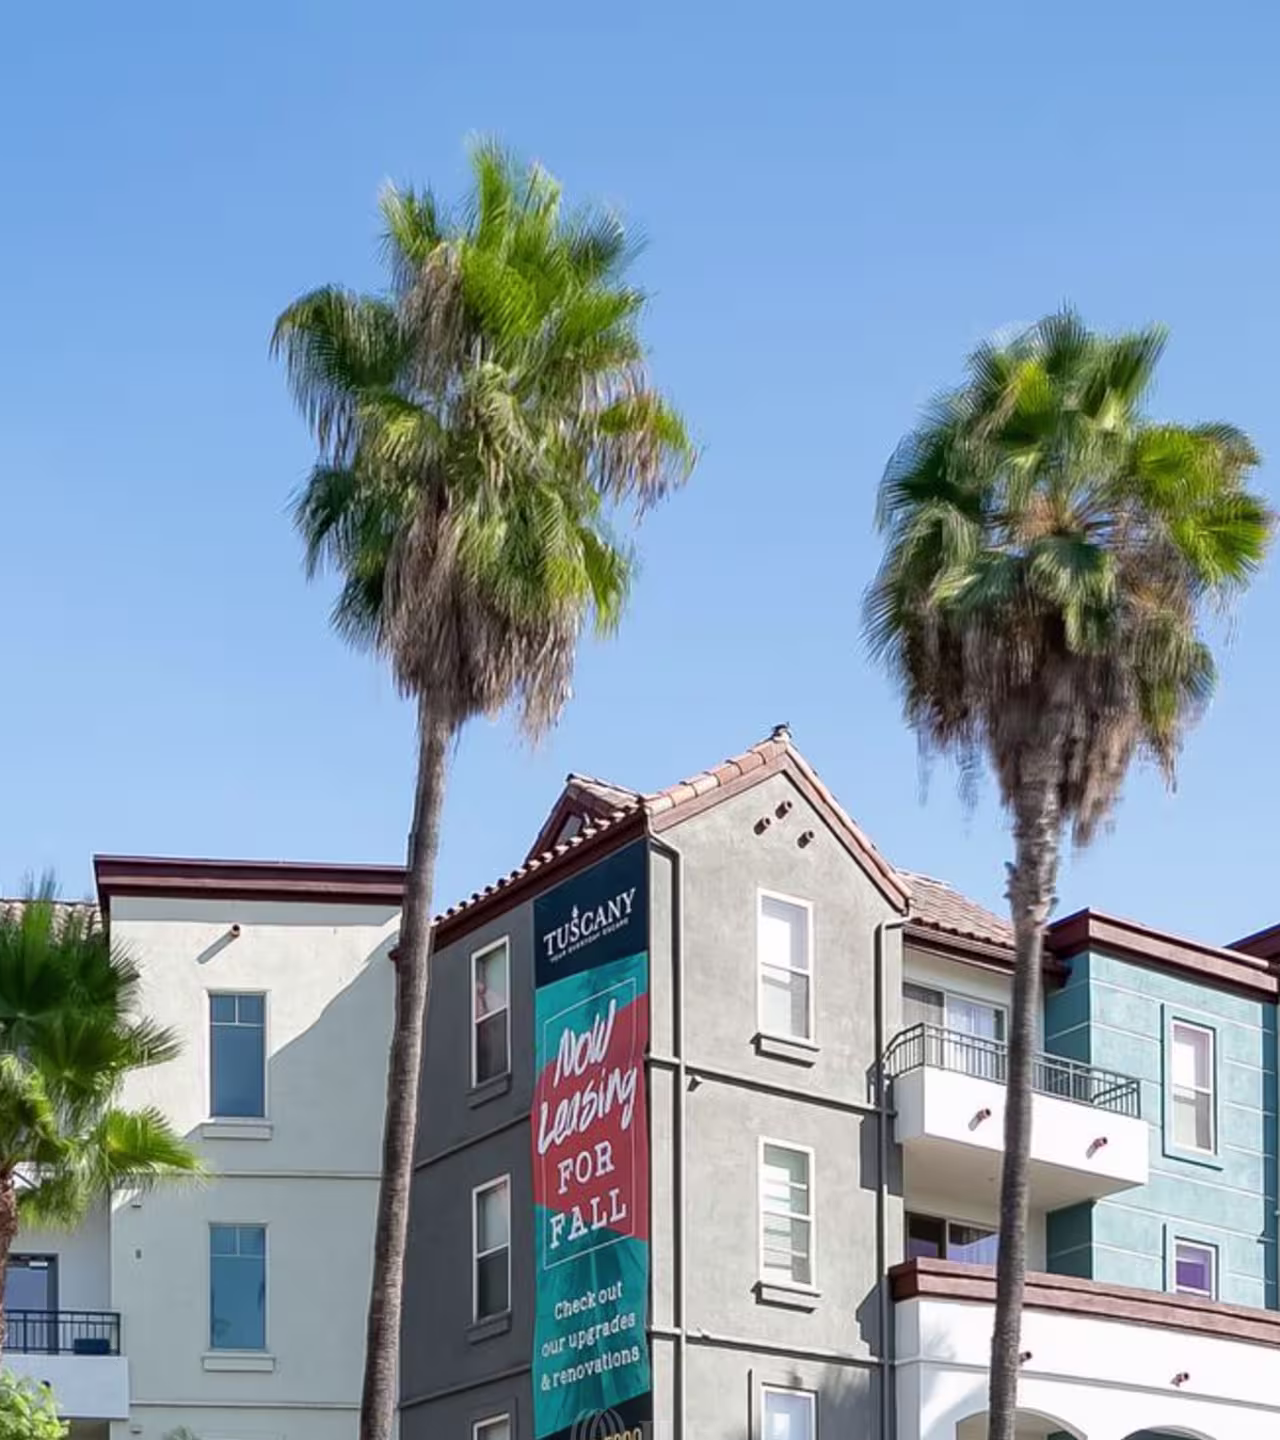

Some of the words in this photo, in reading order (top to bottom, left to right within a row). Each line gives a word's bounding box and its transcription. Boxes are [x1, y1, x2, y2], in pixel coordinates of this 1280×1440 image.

[543, 886, 636, 956] TUSCANY
[537, 1066, 638, 1154] Leasing
[556, 1140, 615, 1194] FOR
[549, 1188, 628, 1250] FALL
[554, 1290, 597, 1321] Check
[598, 1280, 624, 1305] out
[541, 1336, 566, 1358] our
[568, 1311, 637, 1350] upgrades
[540, 1372, 551, 1392] &
[552, 1345, 641, 1388] renovations
